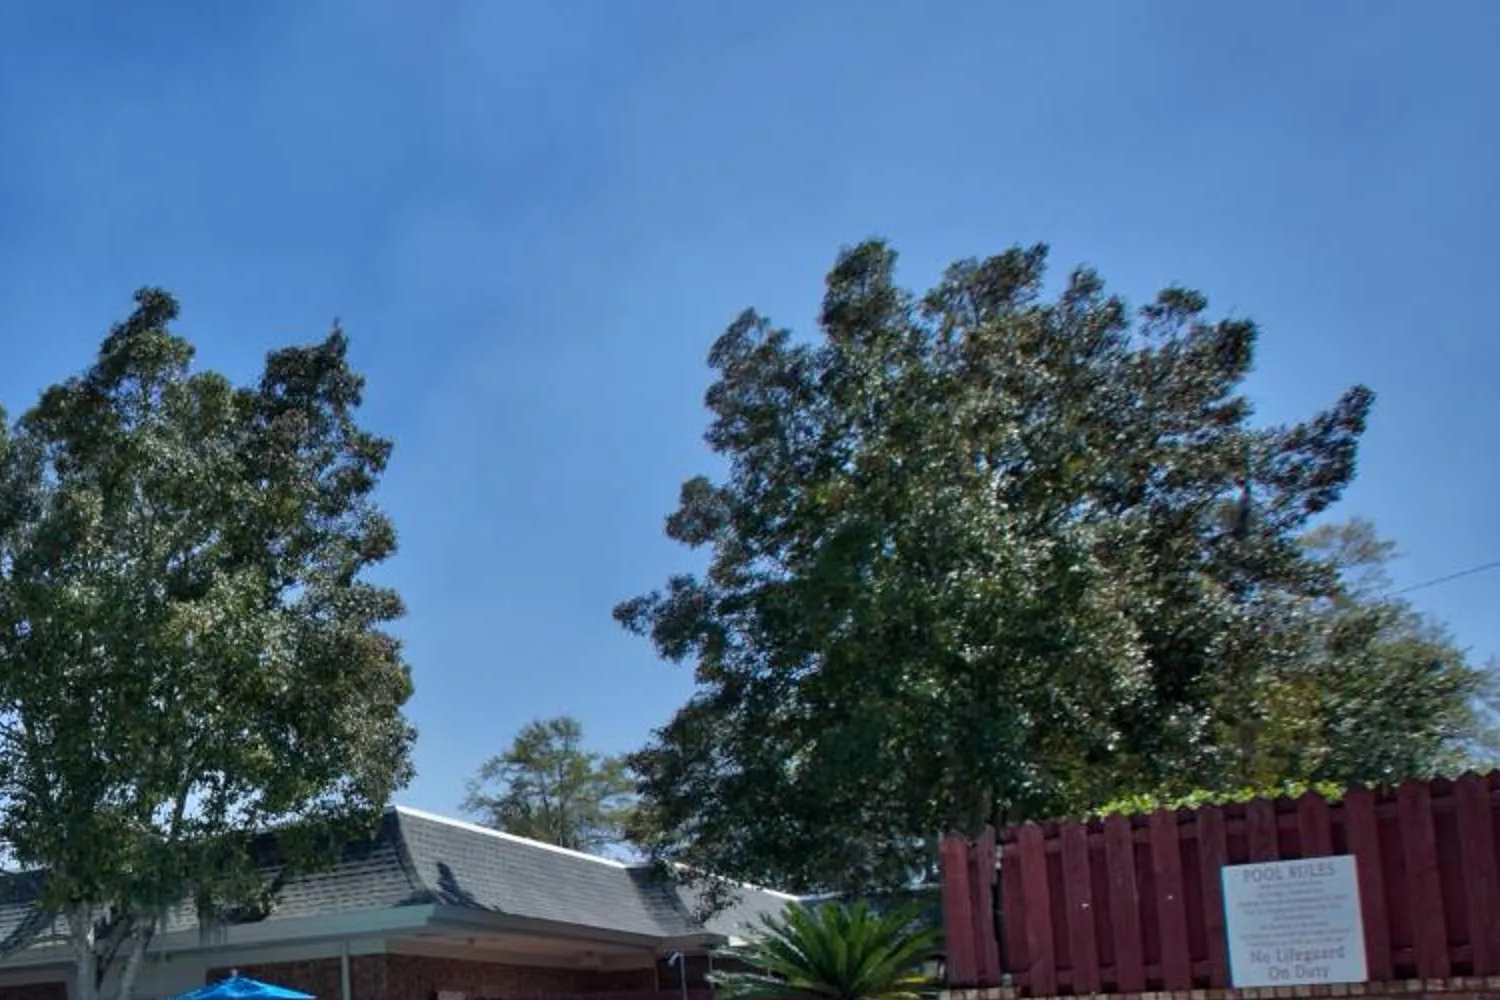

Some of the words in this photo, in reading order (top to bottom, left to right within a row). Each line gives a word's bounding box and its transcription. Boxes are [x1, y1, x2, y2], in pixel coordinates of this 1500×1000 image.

[1243, 866, 1284, 882] POOL
[1288, 861, 1336, 880] RULES
[1249, 949, 1271, 964] No
[1276, 945, 1346, 963] Lifeguard
[1267, 965, 1290, 980] On
[1294, 964, 1331, 980] Duty
